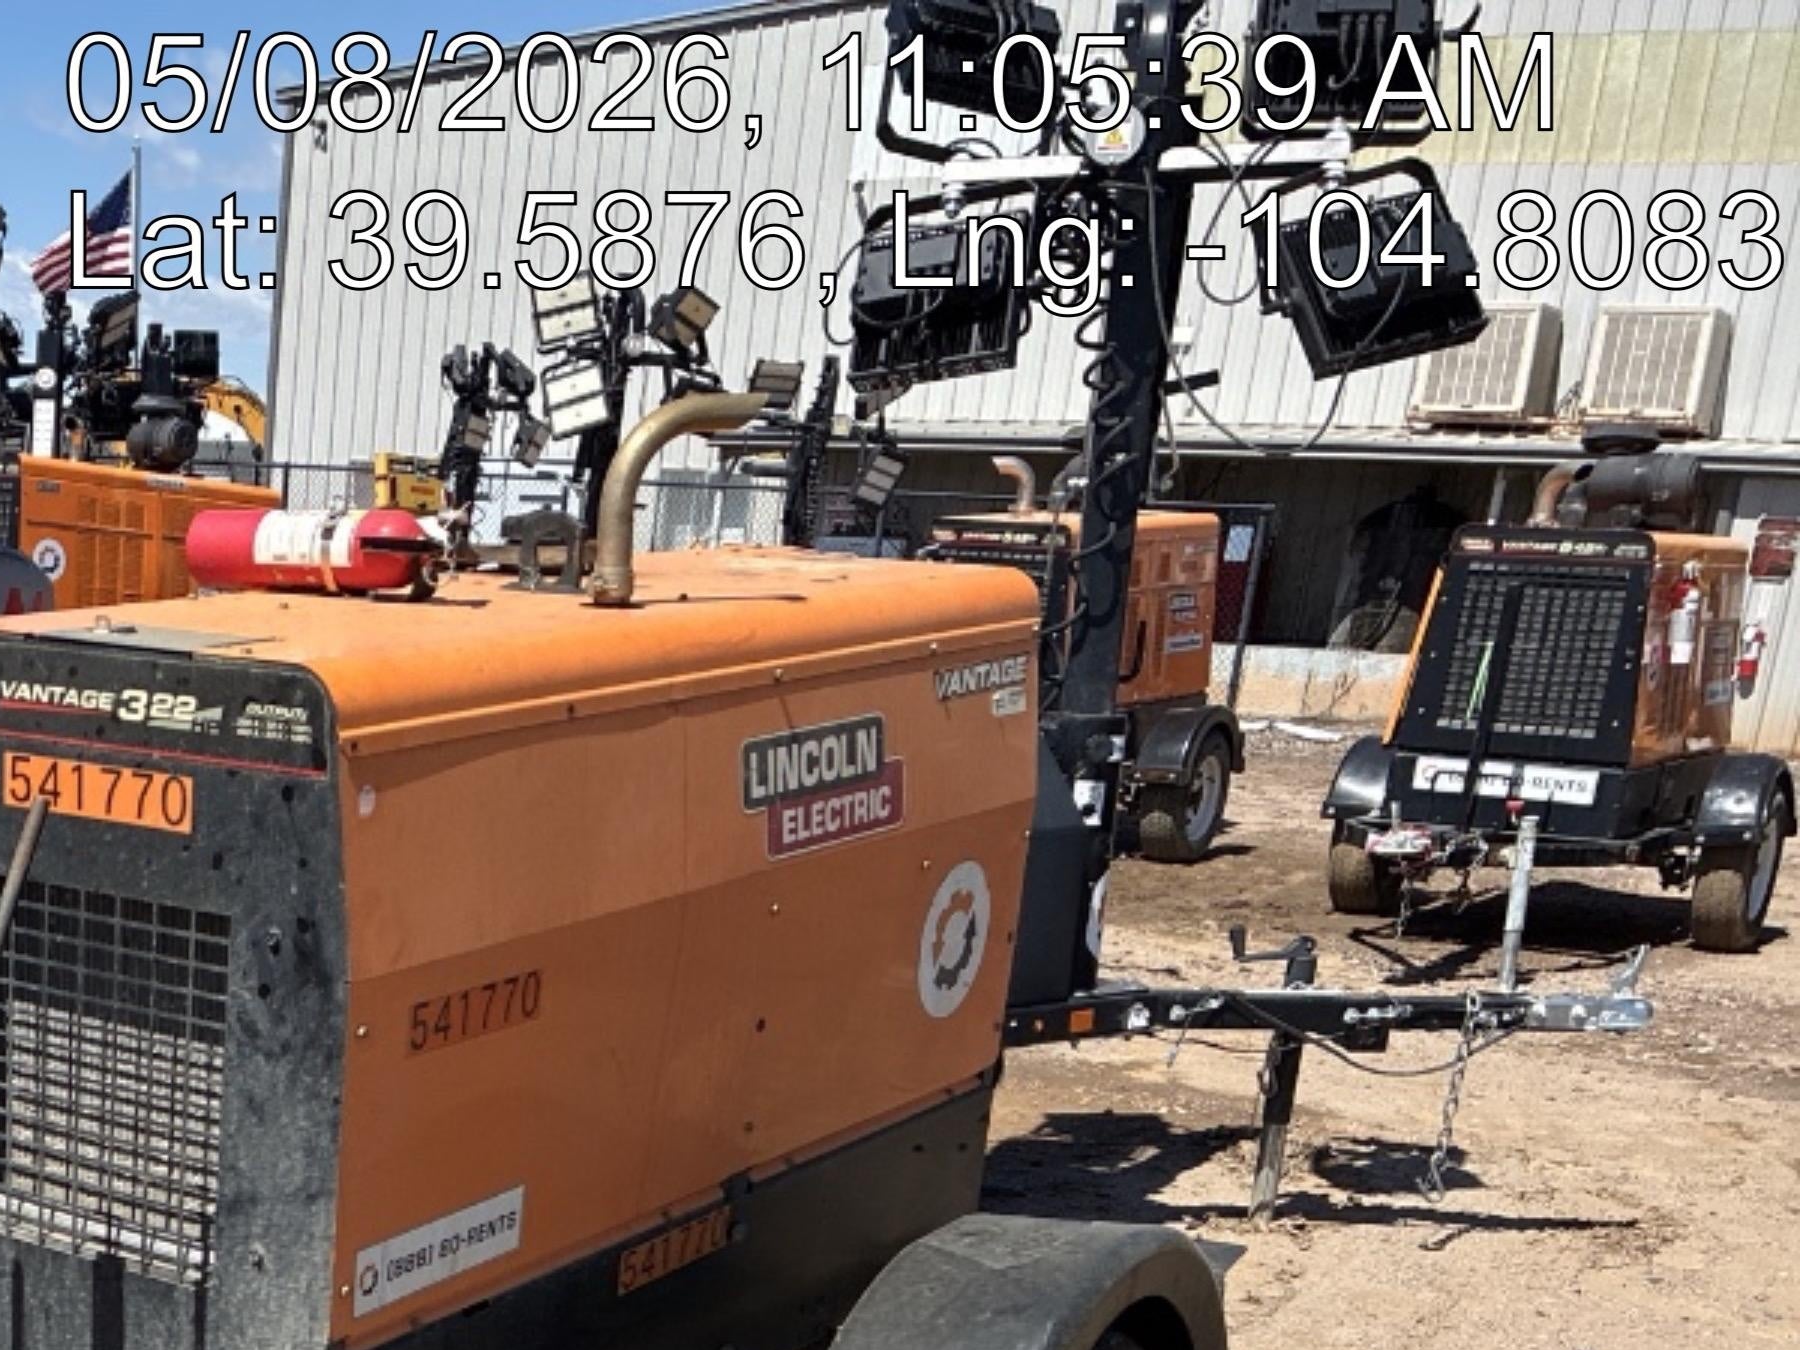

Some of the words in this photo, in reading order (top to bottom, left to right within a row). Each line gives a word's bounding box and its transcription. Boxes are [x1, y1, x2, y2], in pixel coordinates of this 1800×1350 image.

[0, 680, 116, 712] VANTAGE
[117, 688, 197, 722] 322
[934, 656, 1027, 699] VANTAGE
[9, 755, 188, 826] 541770
[749, 725, 878, 800] LINCOLN
[781, 785, 892, 844] ELECTRIC
[410, 970, 542, 1051] 541770
